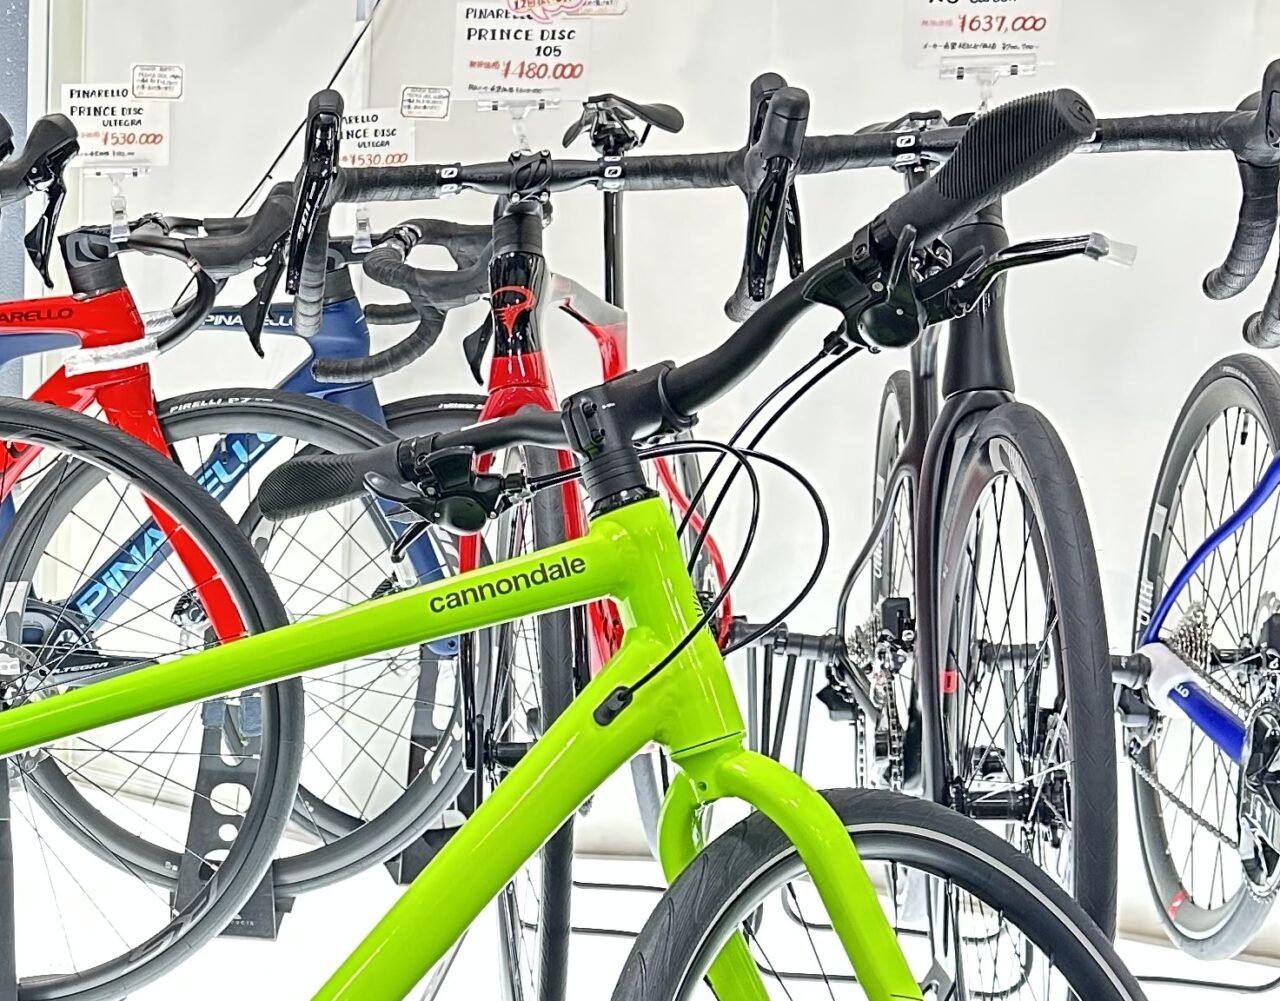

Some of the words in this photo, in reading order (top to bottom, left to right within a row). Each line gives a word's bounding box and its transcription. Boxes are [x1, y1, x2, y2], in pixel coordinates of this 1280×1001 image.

[466, 27, 534, 41] PRINCE
[539, 28, 577, 41] DISC
[535, 45, 563, 58] 105
[69, 88, 129, 99] PINARELLO
[70, 106, 117, 117] PRINCE
[121, 107, 145, 116] DISC
[342, 114, 379, 125] ARELLO
[374, 128, 398, 138] DISC
[201, 314, 295, 328] PINAELLO
[169, 397, 222, 414] PIRELLI
[429, 556, 587, 613] cannondale
